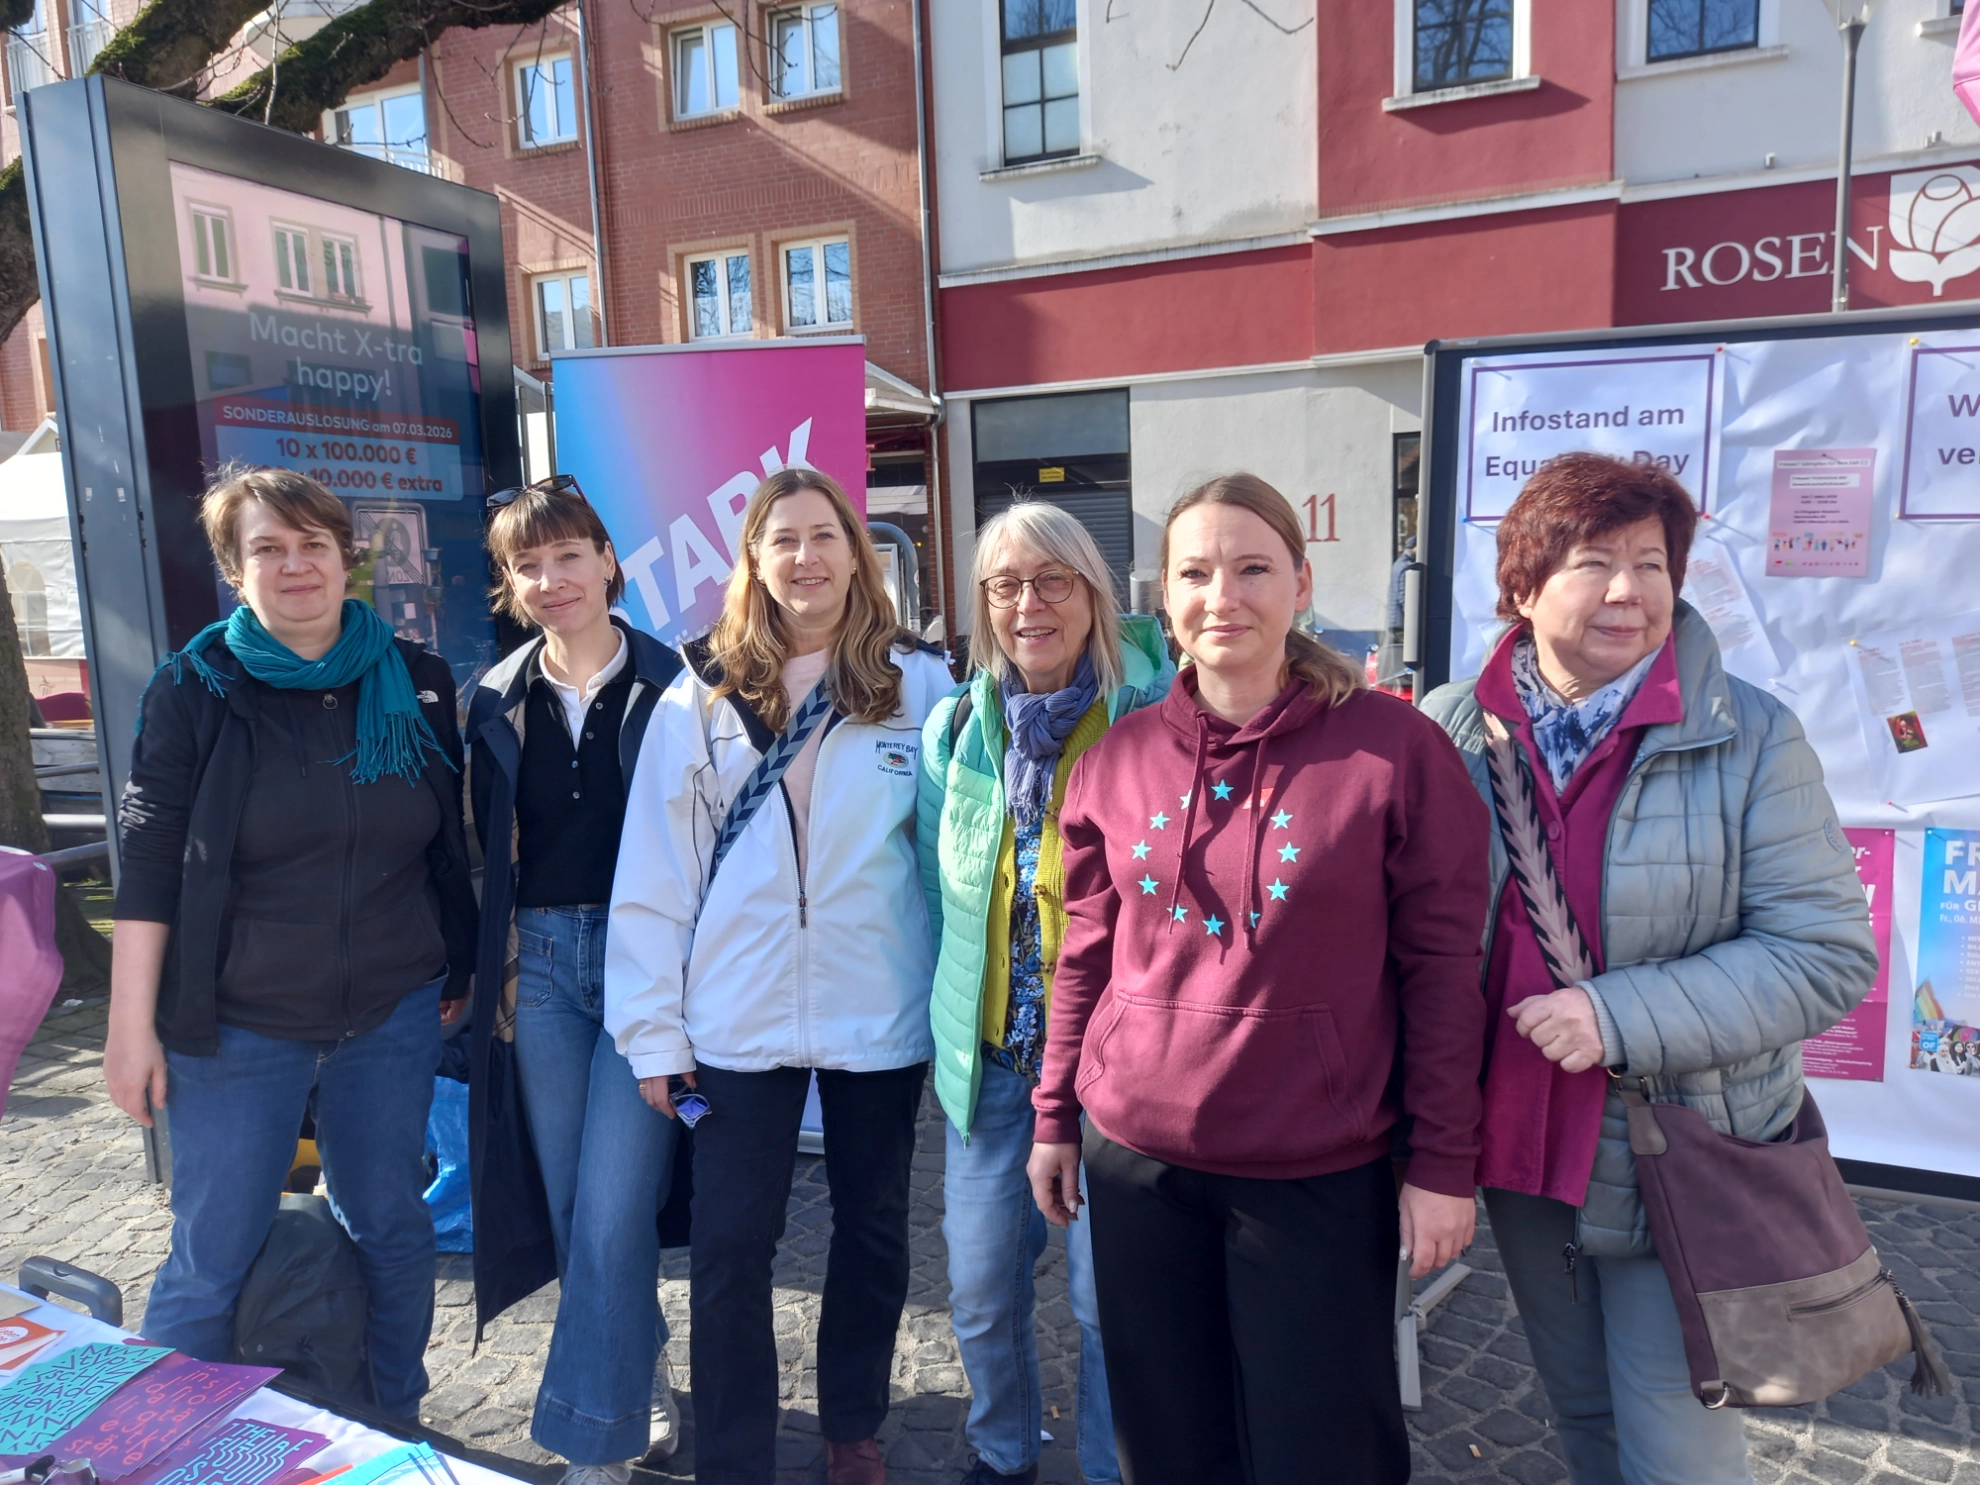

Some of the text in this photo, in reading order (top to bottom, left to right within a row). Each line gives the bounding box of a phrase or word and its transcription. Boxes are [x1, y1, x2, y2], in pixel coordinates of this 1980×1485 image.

[1660, 225, 1884, 291] ROSEN
[250, 312, 423, 366] Macht X-tra
[296, 355, 392, 400] happy!
[222, 405, 453, 439] SONDERAUSLOSUNG am 07.03.2026
[1491, 404, 1686, 434] Infostand am
[276, 437, 418, 465] 10 x 100.000 €
[381, 473, 393, 490] €
[397, 475, 443, 492] extra
[1302, 492, 1340, 543] 11
[905, 745, 919, 760] BAY
[877, 764, 913, 777] CALIFORNIA
[1940, 901, 1960, 911] FÜR
